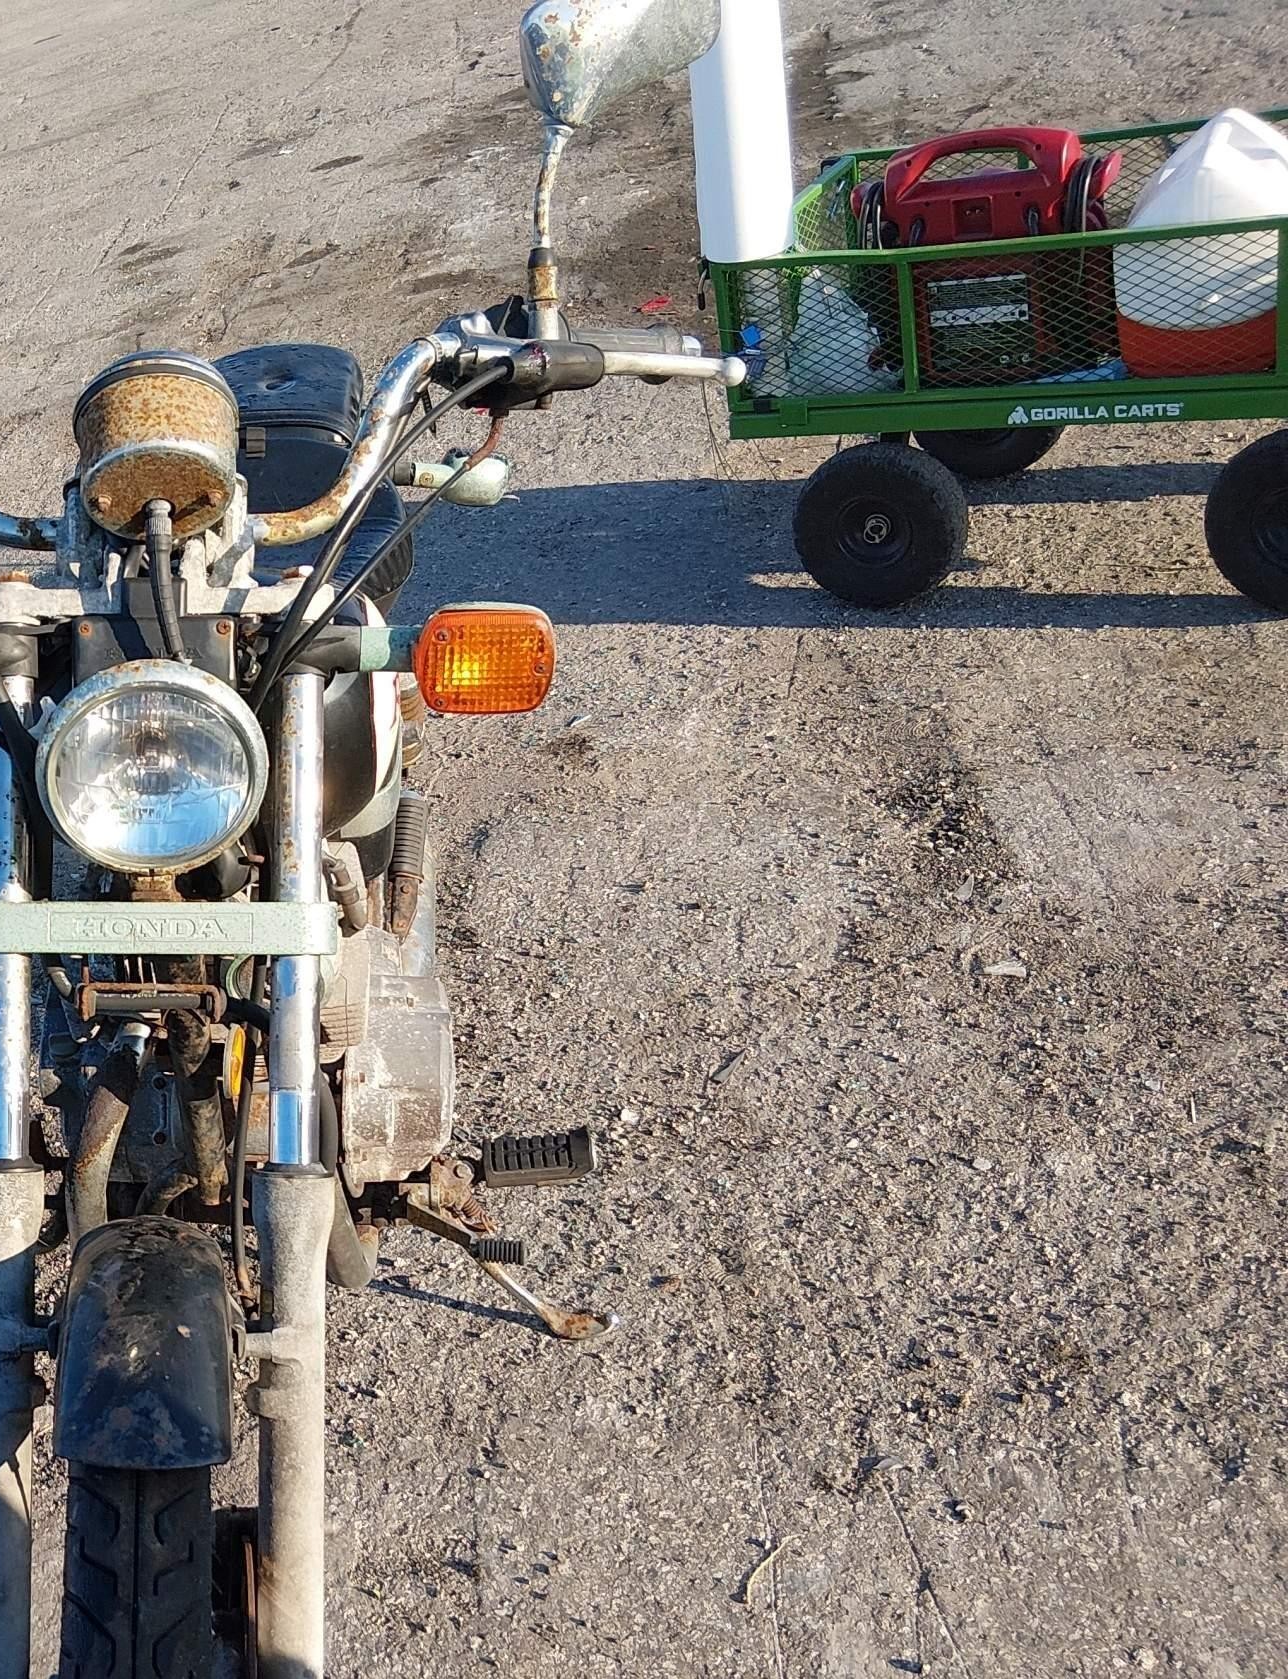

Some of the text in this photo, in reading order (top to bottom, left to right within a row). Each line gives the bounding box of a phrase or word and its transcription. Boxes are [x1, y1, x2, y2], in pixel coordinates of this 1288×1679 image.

[1030, 403, 1181, 421] GORILLA CARTS
[73, 917, 229, 939] HONDA
